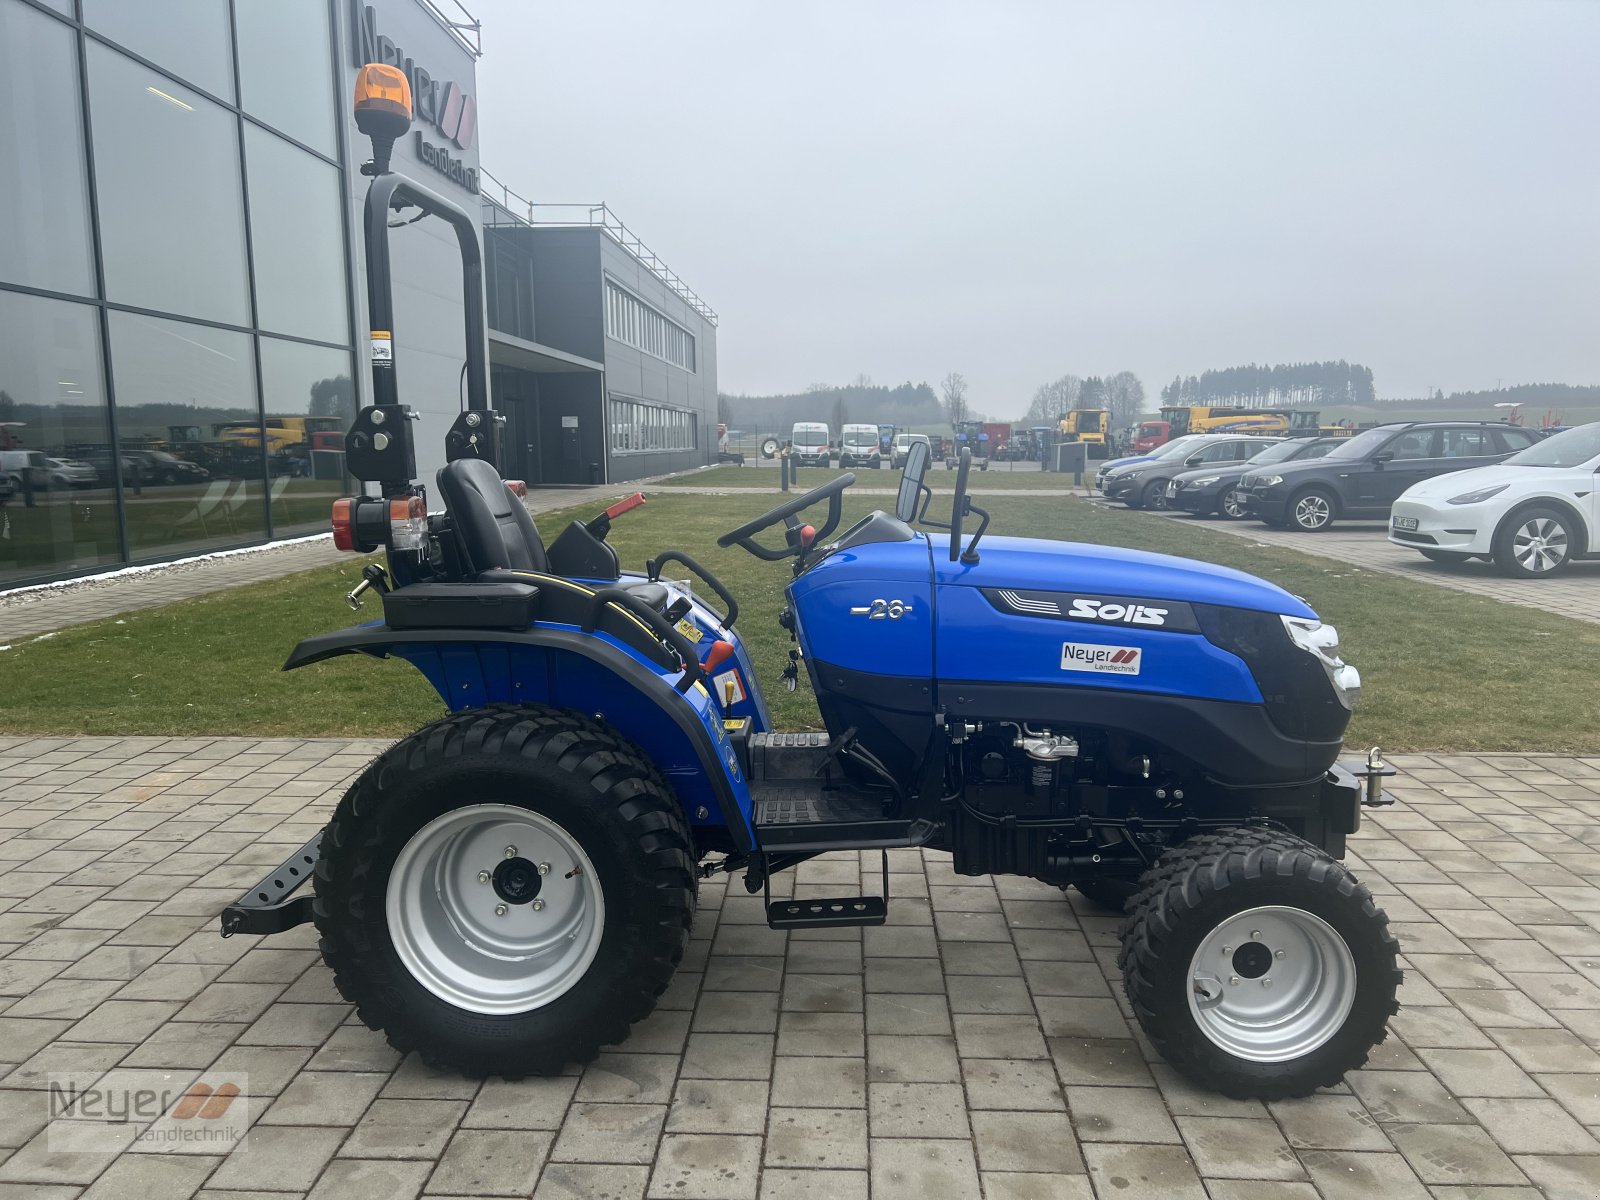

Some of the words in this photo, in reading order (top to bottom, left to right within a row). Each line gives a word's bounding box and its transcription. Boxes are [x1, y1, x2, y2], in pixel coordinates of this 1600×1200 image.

[416, 131, 479, 195] Landtechnik
[1064, 645, 1111, 664] Neyer
[1094, 663, 1136, 673] Landtechnik
